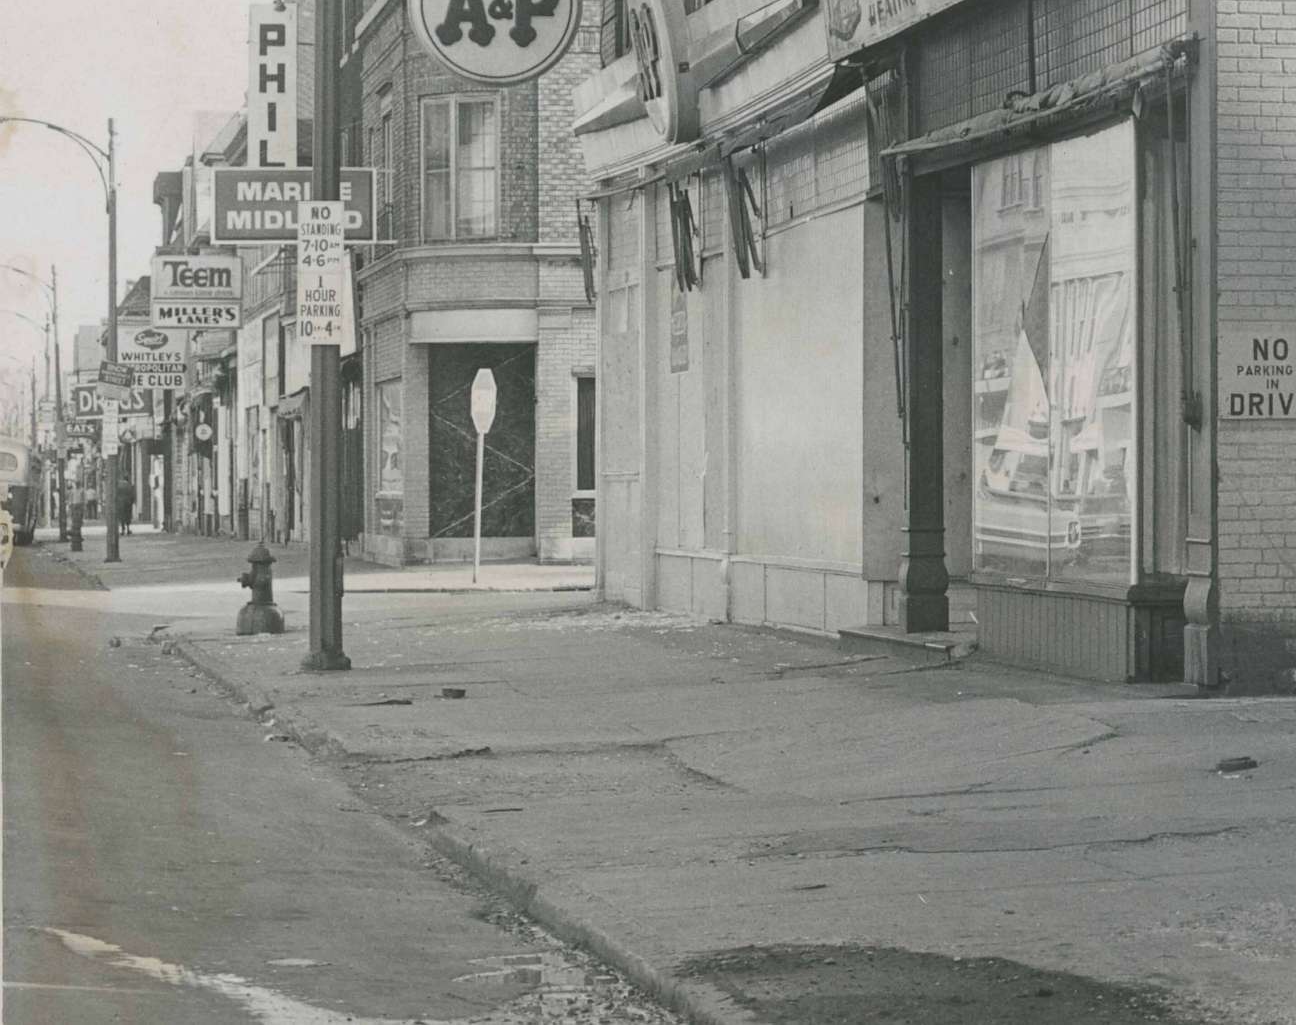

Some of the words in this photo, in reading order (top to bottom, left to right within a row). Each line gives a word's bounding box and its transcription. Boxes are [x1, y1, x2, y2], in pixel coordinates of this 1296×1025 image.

[236, 181, 353, 202] MARIE
[311, 205, 332, 221] NO
[226, 209, 363, 231] MIDLD
[300, 222, 342, 235] STANDING
[162, 260, 232, 288] Teem
[318, 276, 323, 288] 1
[305, 289, 337, 302] HOUR
[301, 304, 342, 318] PARKING
[177, 315, 220, 324] LANES
[1252, 338, 1289, 361] NO
[134, 364, 183, 372] ROPOLITAN
[1236, 365, 1294, 376] PARKING
[147, 375, 183, 386] CLUB
[1266, 379, 1279, 390] IN
[80, 390, 145, 411] DRGS
